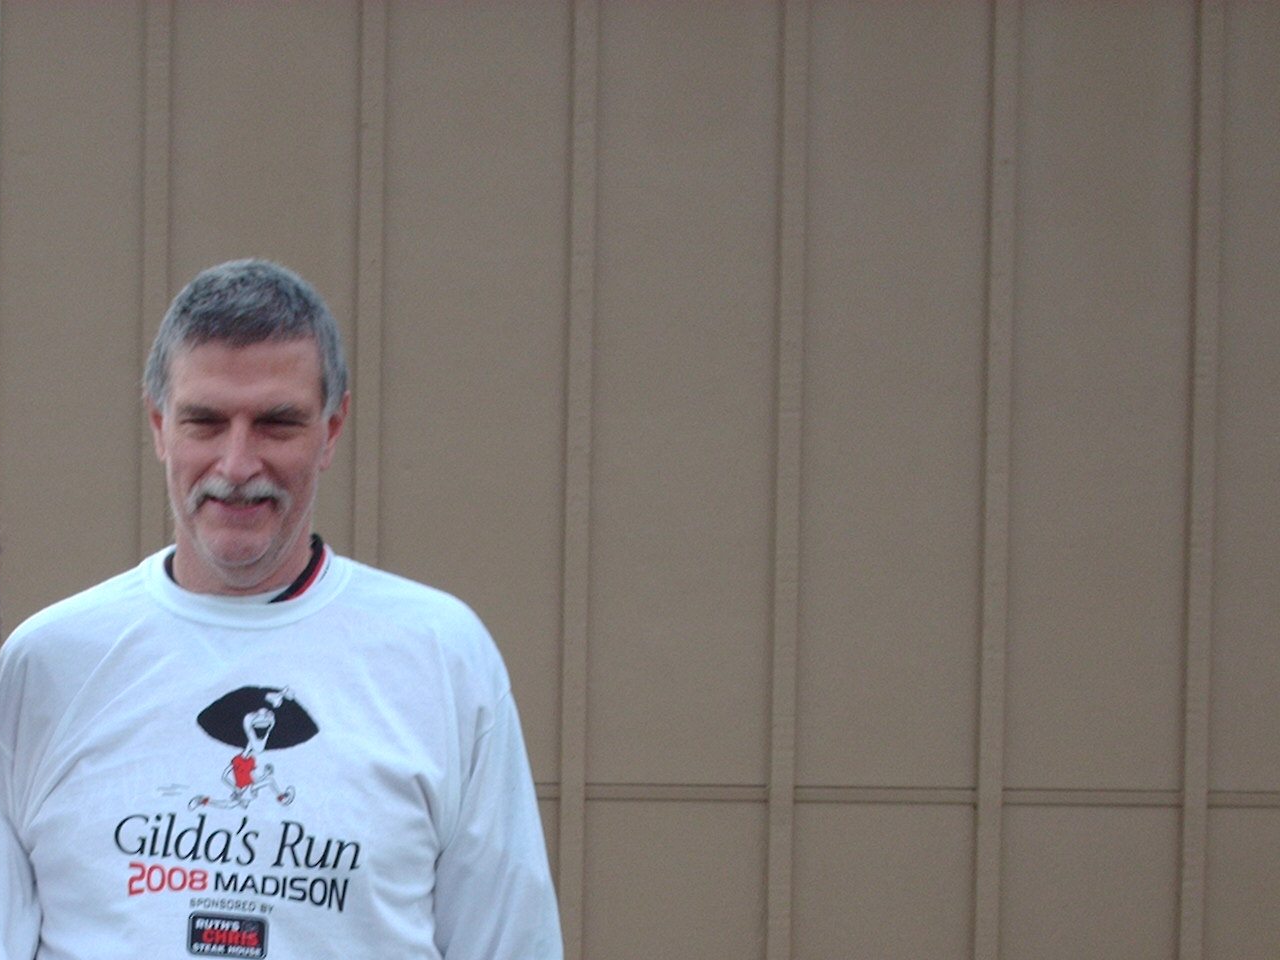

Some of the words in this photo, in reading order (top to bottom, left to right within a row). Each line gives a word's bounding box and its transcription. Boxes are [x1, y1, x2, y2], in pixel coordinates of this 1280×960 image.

[113, 812, 260, 867] Gilda's
[271, 819, 362, 871] Run
[127, 861, 209, 897] 2008
[213, 871, 350, 912] MADISON
[189, 897, 256, 912] SPONSORED
[260, 902, 274, 914] BY
[202, 927, 259, 948] CHRIS
